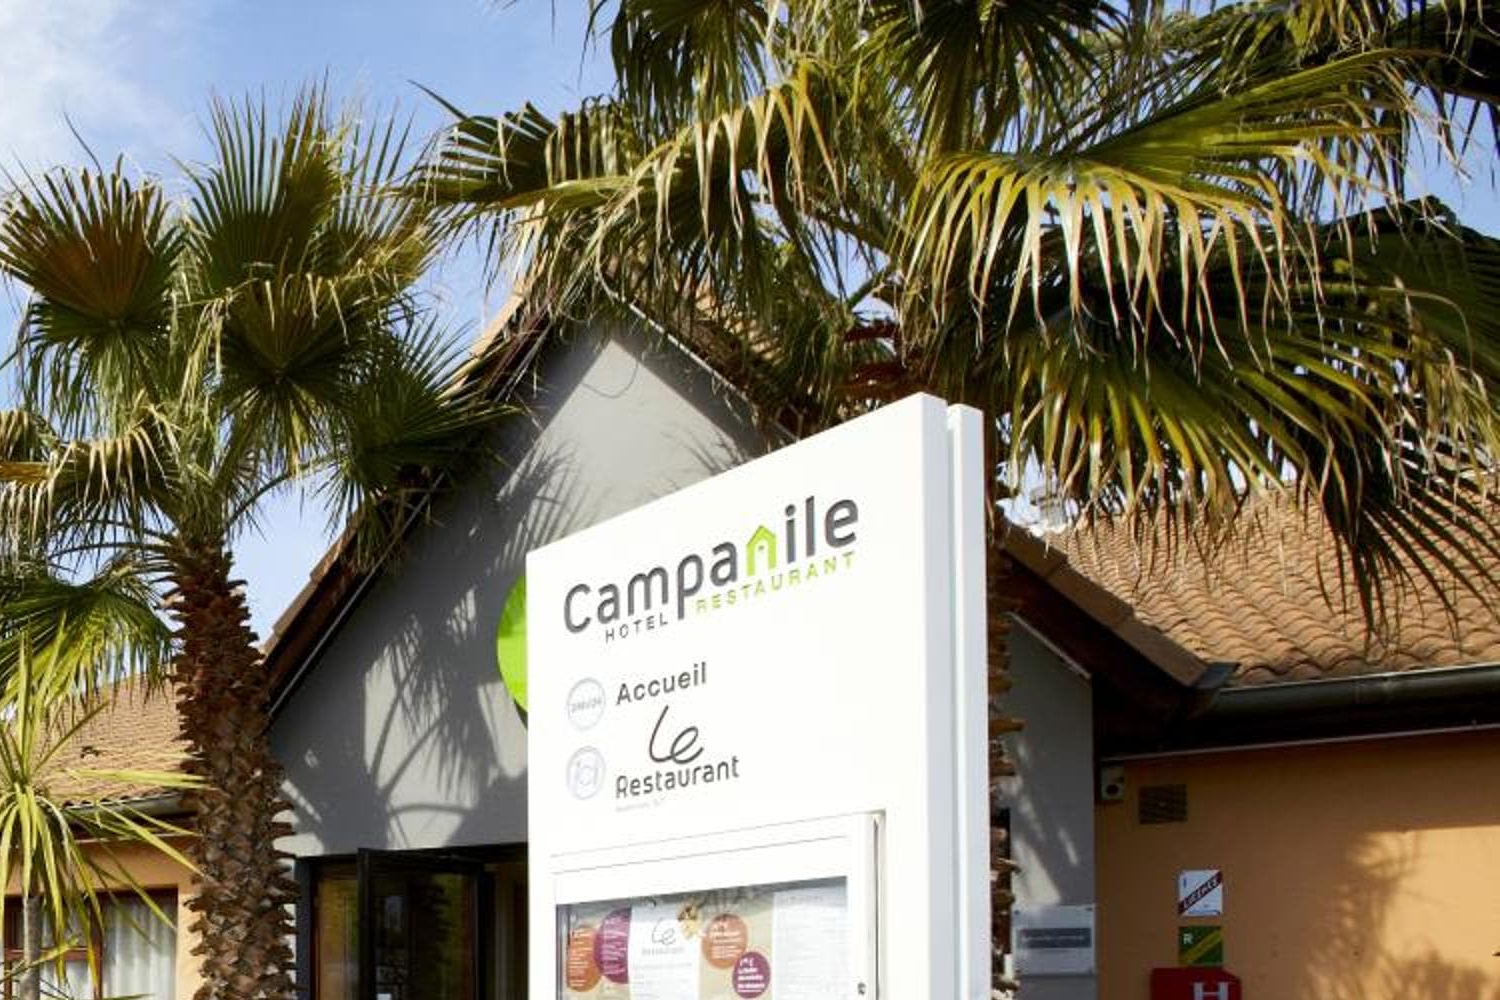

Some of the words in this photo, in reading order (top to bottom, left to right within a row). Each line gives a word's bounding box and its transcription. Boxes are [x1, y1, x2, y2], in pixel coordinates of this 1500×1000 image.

[564, 495, 859, 633] Campanile
[605, 612, 669, 643] HOTEL
[696, 551, 855, 613] RESTAURANT
[616, 661, 706, 706] Accueil
[649, 704, 704, 765] Le
[616, 755, 739, 799] Restaurant
[1183, 934, 1193, 945] R
